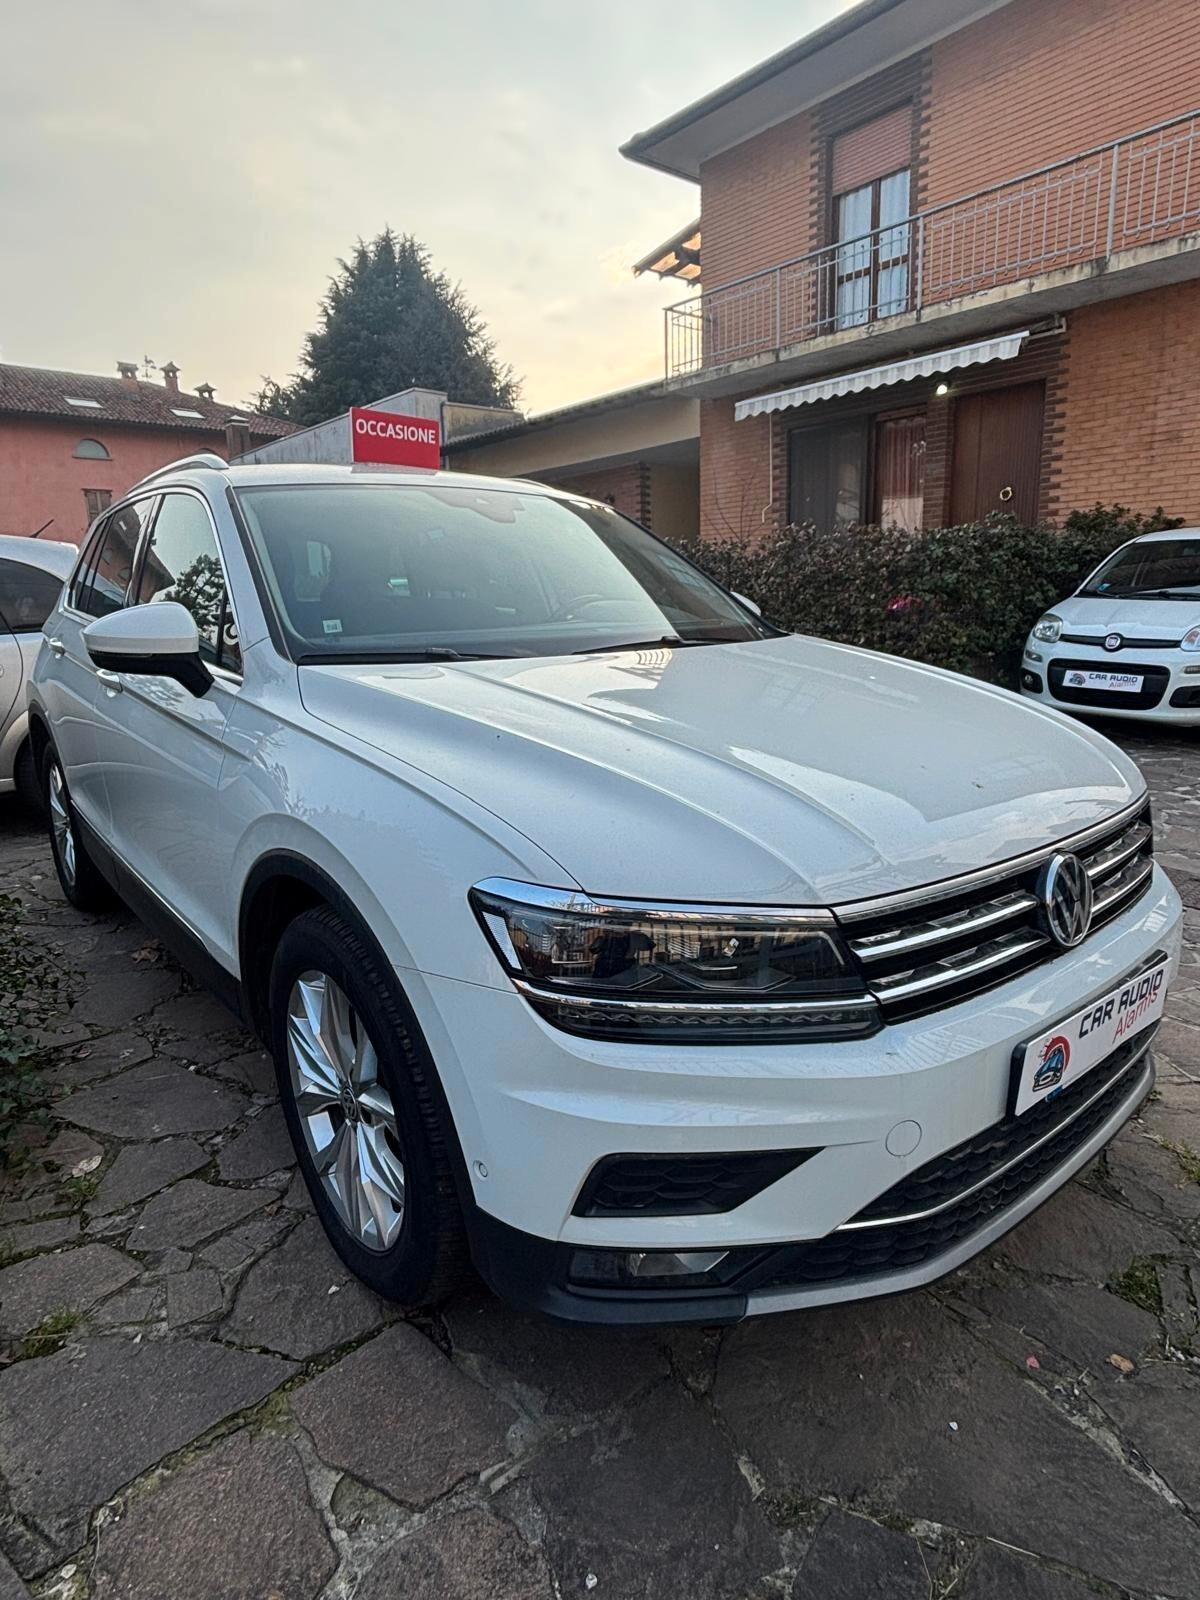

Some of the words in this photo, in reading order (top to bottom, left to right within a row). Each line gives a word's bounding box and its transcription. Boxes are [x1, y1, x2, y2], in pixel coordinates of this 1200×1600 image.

[355, 418, 436, 444] OCCASIONE
[1088, 673, 1108, 681] CAR
[1109, 674, 1138, 683] AUDIO
[1078, 999, 1115, 1039] CAR
[1117, 968, 1164, 1015] AUDIO
